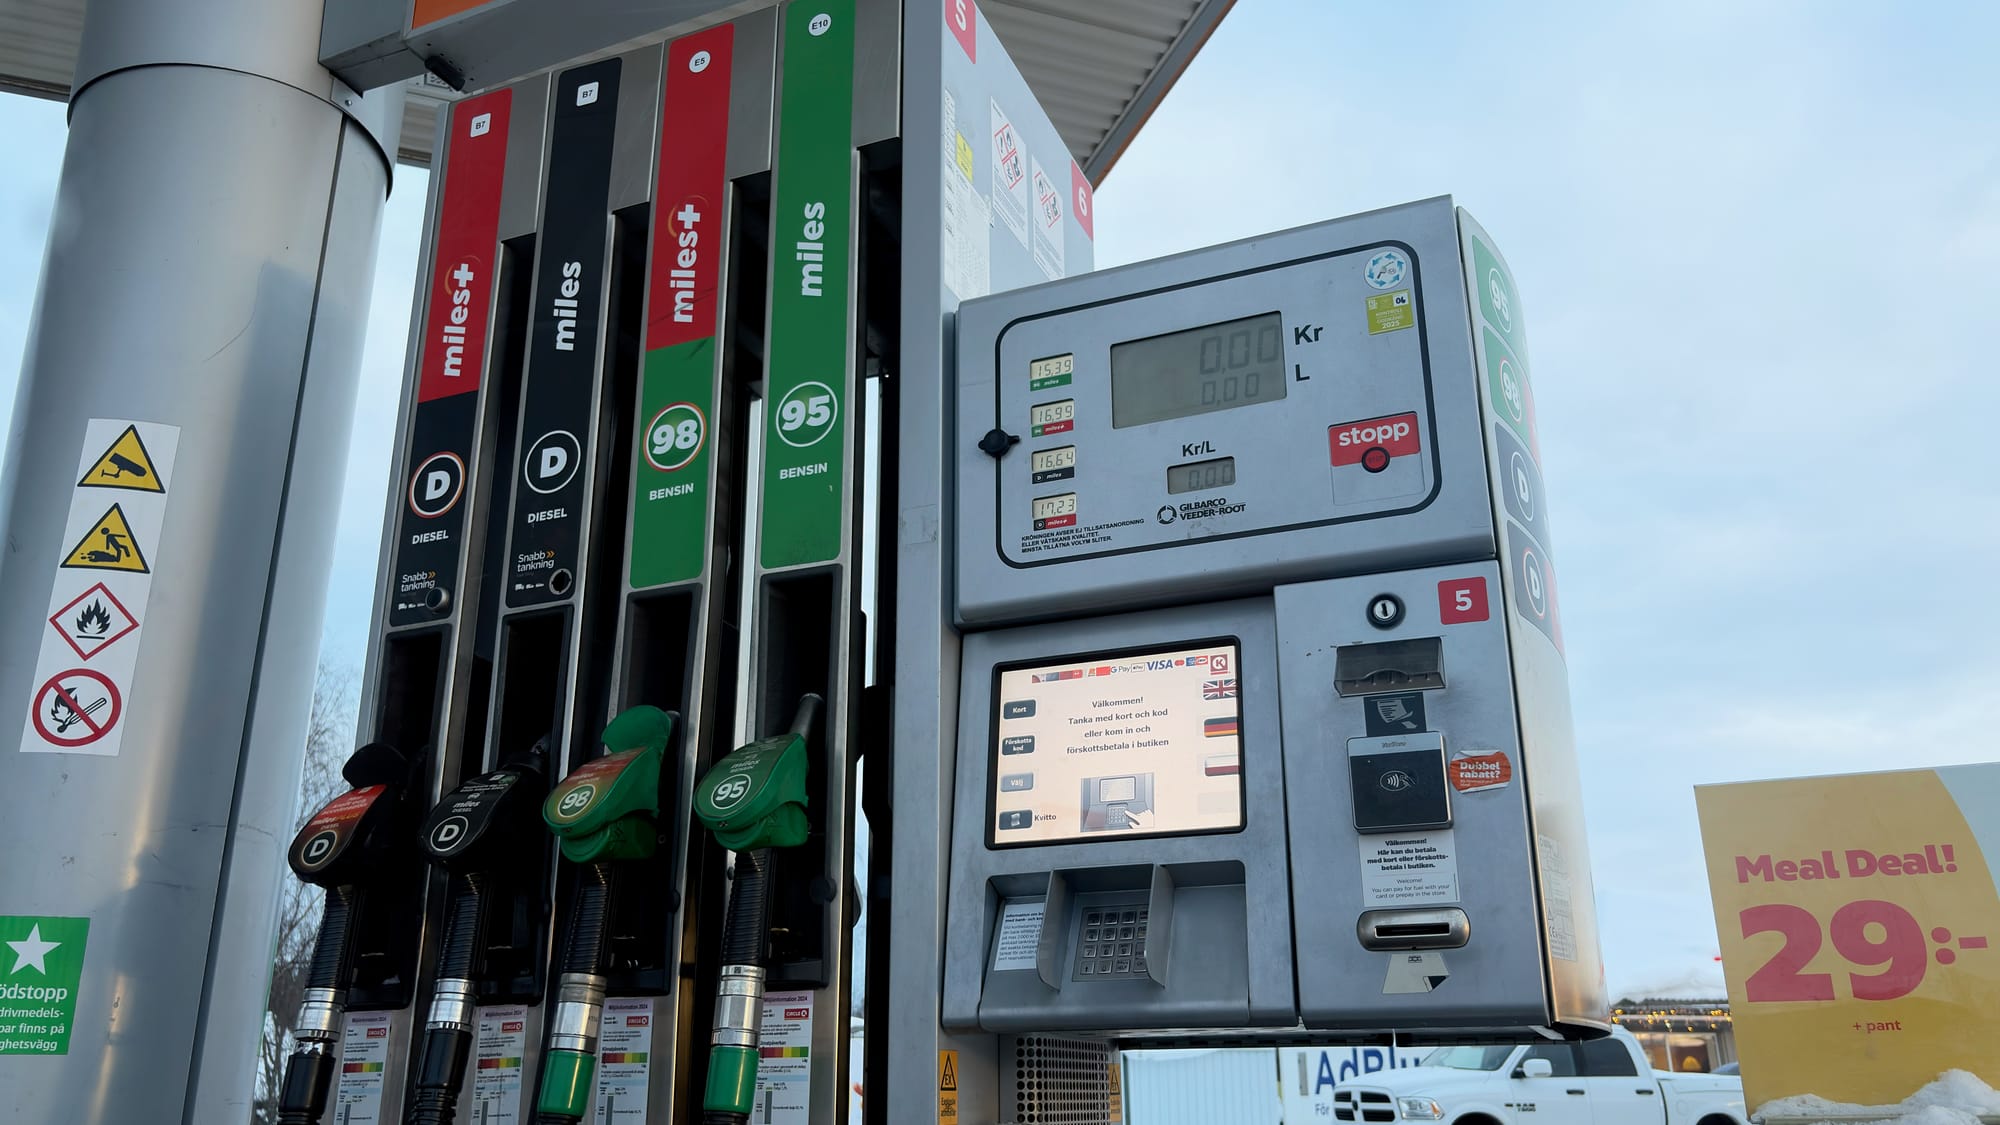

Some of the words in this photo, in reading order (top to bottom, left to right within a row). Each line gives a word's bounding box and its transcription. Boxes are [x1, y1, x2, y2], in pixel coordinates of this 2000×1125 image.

[811, 19, 828, 31] E10
[694, 57, 706, 67] E5
[581, 88, 593, 99] B7
[475, 120, 486, 130] B7
[1078, 187, 1088, 217] 6
[797, 202, 825, 297] miles
[670, 204, 701, 323] miles+
[554, 261, 581, 351] miles
[443, 263, 473, 377] miles+
[1294, 324, 1323, 345] Kr
[1038, 359, 1072, 377] 15,39
[1295, 364, 1310, 382] L
[781, 394, 831, 431] 95
[1040, 405, 1073, 423] 16,99
[652, 419, 698, 455] 98
[1338, 422, 1410, 446] stopp
[1181, 441, 1216, 457] Kr/L
[539, 446, 568, 479] D
[1040, 451, 1074, 469] 16,64
[780, 463, 828, 480] BENSIN
[425, 470, 450, 501] D
[649, 483, 694, 502] BENSIN
[1516, 467, 1529, 503] D
[1041, 498, 1075, 516] 17,23
[1179, 497, 1227, 512] GILBARCO
[1180, 503, 1246, 521] VEEDER-ROOT
[528, 507, 567, 523] DIESEL
[412, 529, 449, 545] DIESEL
[1055, 529, 1074, 537] AVSER
[1071, 539, 1091, 547] VOLYM
[517, 558, 555, 573] tankning
[518, 551, 546, 563] Snabb
[401, 578, 435, 592] tankning
[402, 571, 428, 583] Snabb
[1529, 565, 1540, 600] D
[1455, 589, 1473, 611] 5
[1118, 664, 1131, 673] Pay
[1146, 659, 1174, 671] VISA
[1012, 706, 1027, 714] Kort
[1092, 697, 1144, 708] Välkommen!
[1068, 716, 1093, 725] Tanka
[1095, 714, 1113, 723] med
[1115, 712, 1133, 721] kort
[1134, 710, 1150, 719] och
[1152, 708, 1168, 717] kod
[1084, 729, 1102, 738] eller
[1105, 727, 1123, 736] kom
[1125, 726, 1134, 734] in
[1135, 725, 1151, 734] och
[1066, 741, 1130, 754] förskottsbetala
[1137, 738, 1169, 748] butiken
[1460, 761, 1501, 770] Dubbel
[1460, 770, 1501, 778] rabatt?
[715, 780, 747, 801] 95
[1010, 779, 1024, 787] Välj
[561, 790, 591, 810] 98
[1034, 814, 1057, 822] Kvitto
[437, 824, 460, 842] D
[308, 838, 330, 858] D
[1385, 838, 1427, 846] Välkommen!
[1407, 862, 1436, 870] butiken.
[1735, 850, 1841, 884] Meal
[1845, 844, 1958, 878] Deal!
[1739, 899, 1989, 1003] 29:-
[19, 1023, 47, 1034] finns
[50, 1023, 65, 1036] på
[1852, 1021, 1862, 1031] +
[1867, 1019, 1902, 1034] pant
